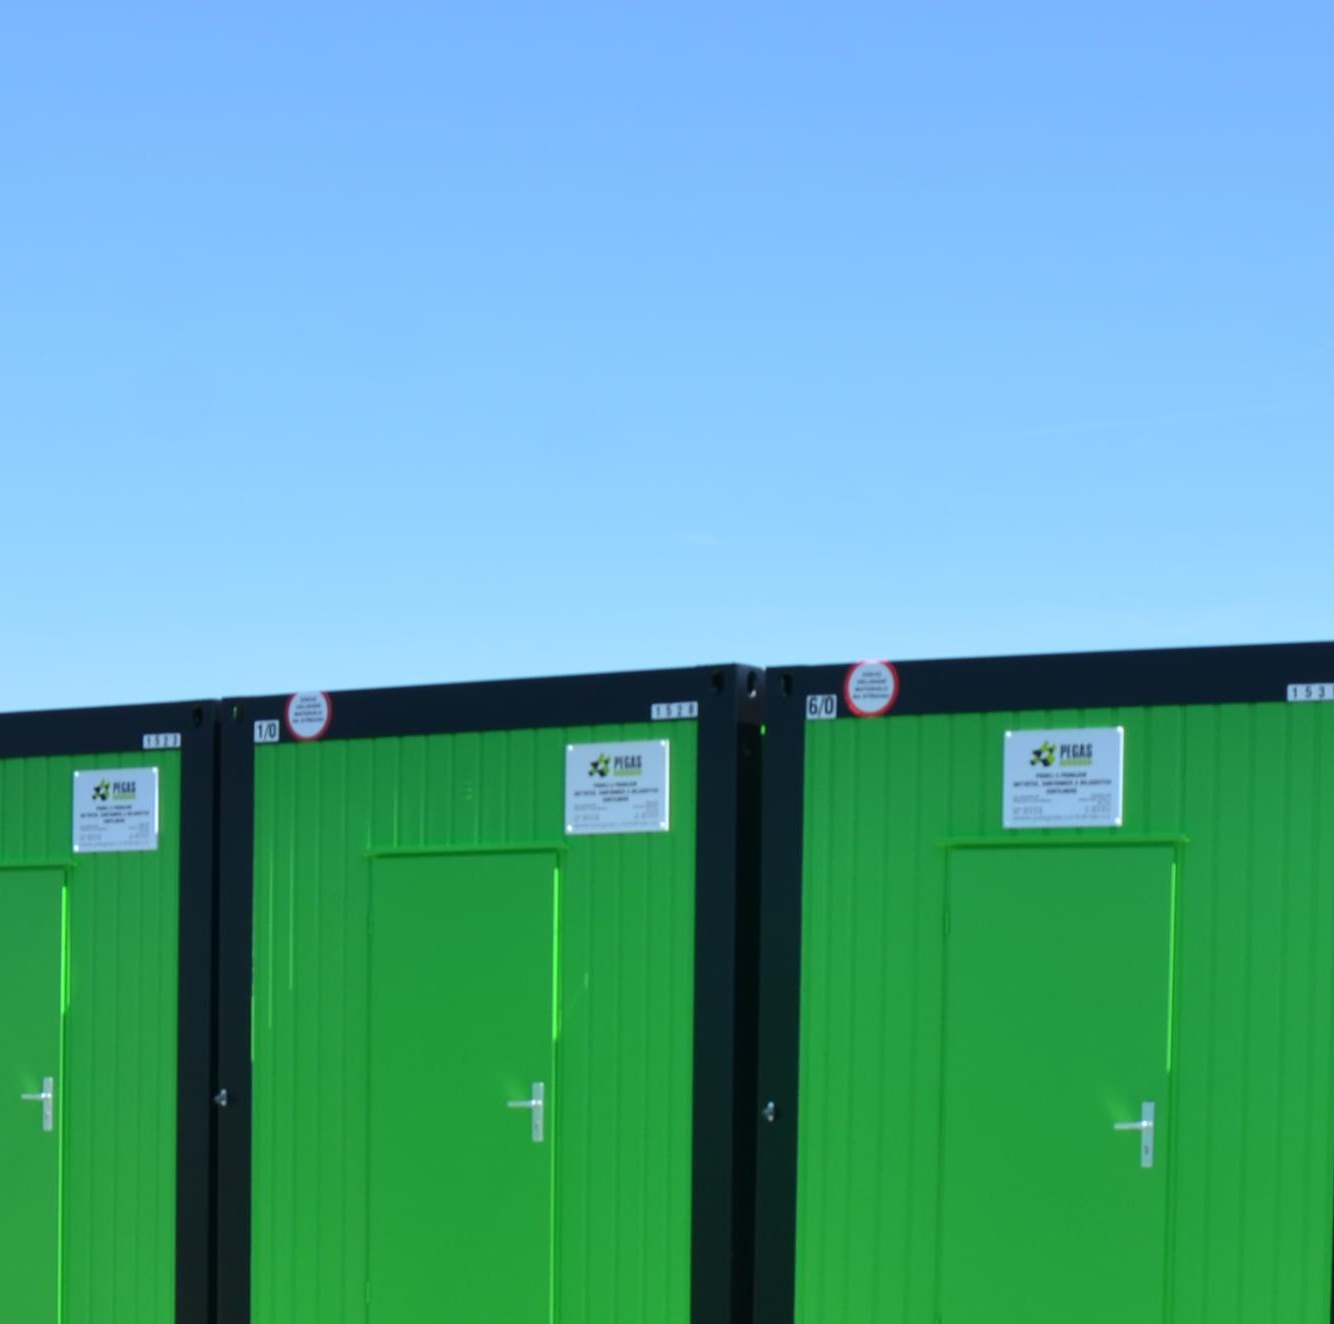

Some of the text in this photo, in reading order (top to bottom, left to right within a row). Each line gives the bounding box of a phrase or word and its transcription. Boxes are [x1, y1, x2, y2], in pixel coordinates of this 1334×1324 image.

[808, 696, 835, 717] 6/0
[257, 721, 277, 740] 1/0
[1060, 743, 1093, 758] PEGAS
[614, 755, 642, 769] PEGAS
[113, 781, 136, 794] PEGAS
